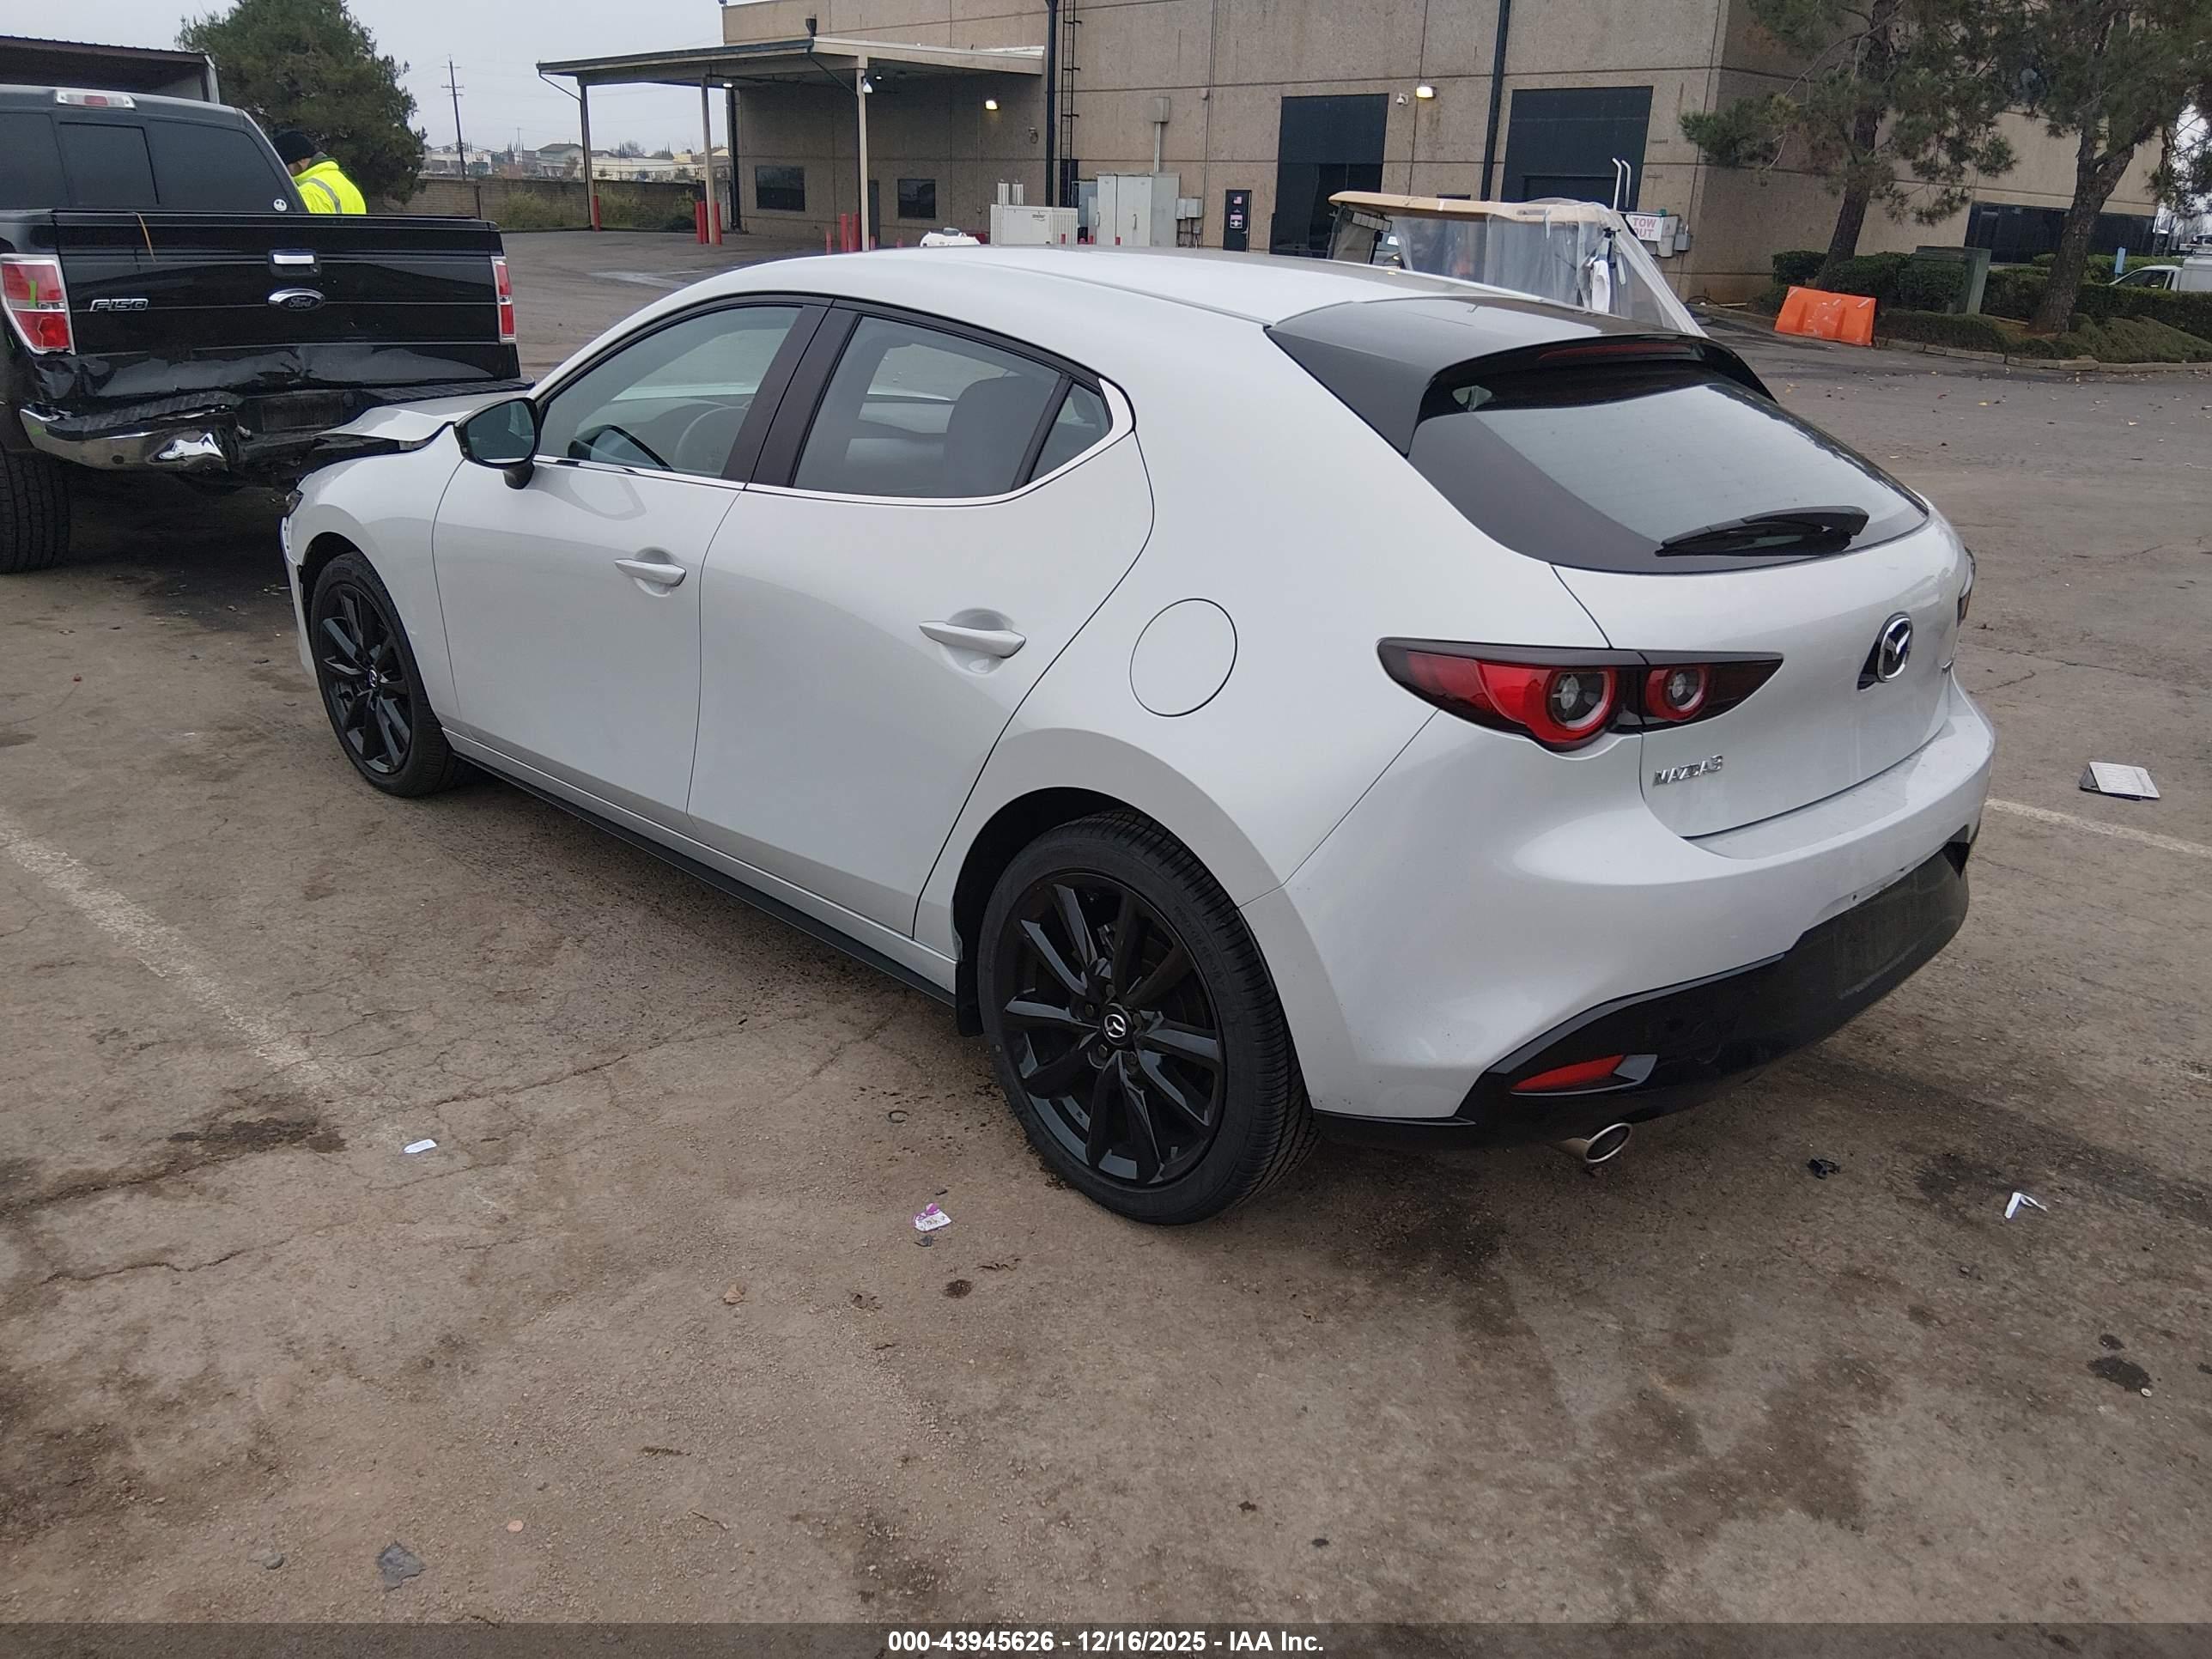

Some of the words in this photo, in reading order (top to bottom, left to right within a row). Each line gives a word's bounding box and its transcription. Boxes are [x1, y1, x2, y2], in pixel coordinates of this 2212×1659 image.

[1633, 218, 1656, 228] TOW
[288, 296, 313, 308] Ford
[1653, 754, 1724, 787] MAZDA3
